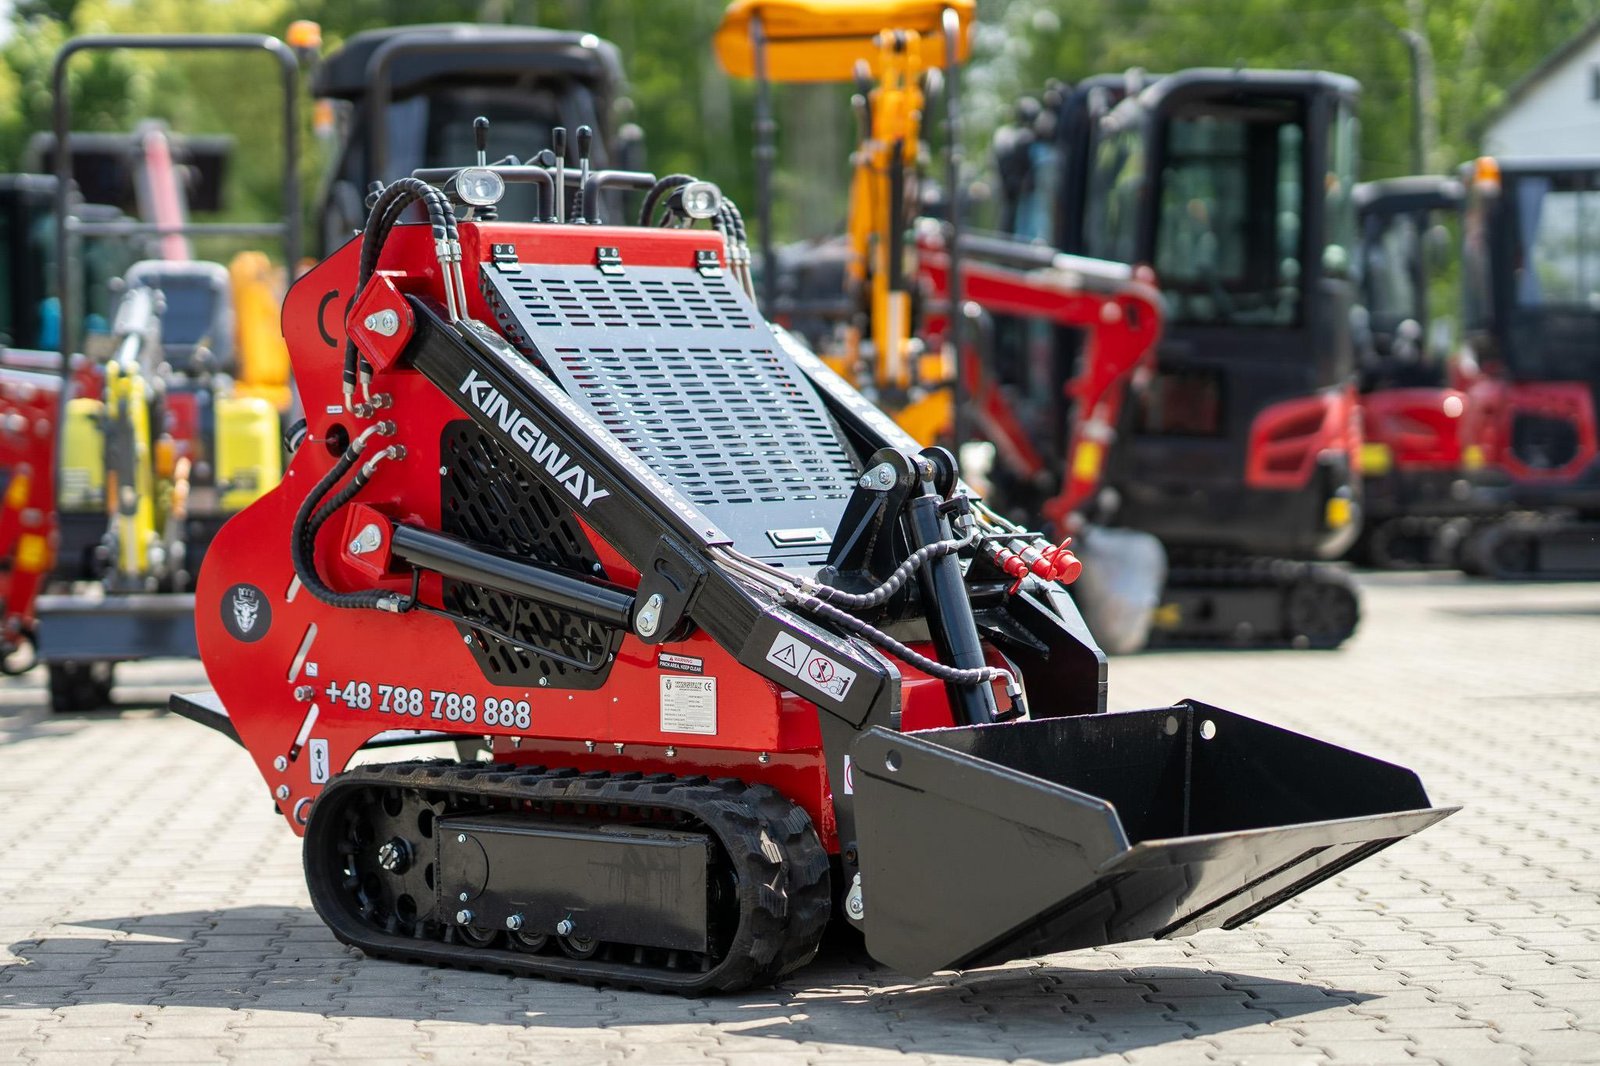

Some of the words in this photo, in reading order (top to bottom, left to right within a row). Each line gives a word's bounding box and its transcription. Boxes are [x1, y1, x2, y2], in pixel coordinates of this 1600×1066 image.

[459, 369, 610, 507] KINGWAY
[502, 348, 698, 520] www.importerkoparek.eu
[325, 681, 372, 710] +48
[379, 684, 424, 717] 788
[430, 691, 477, 723] 788
[483, 697, 532, 730] 888
